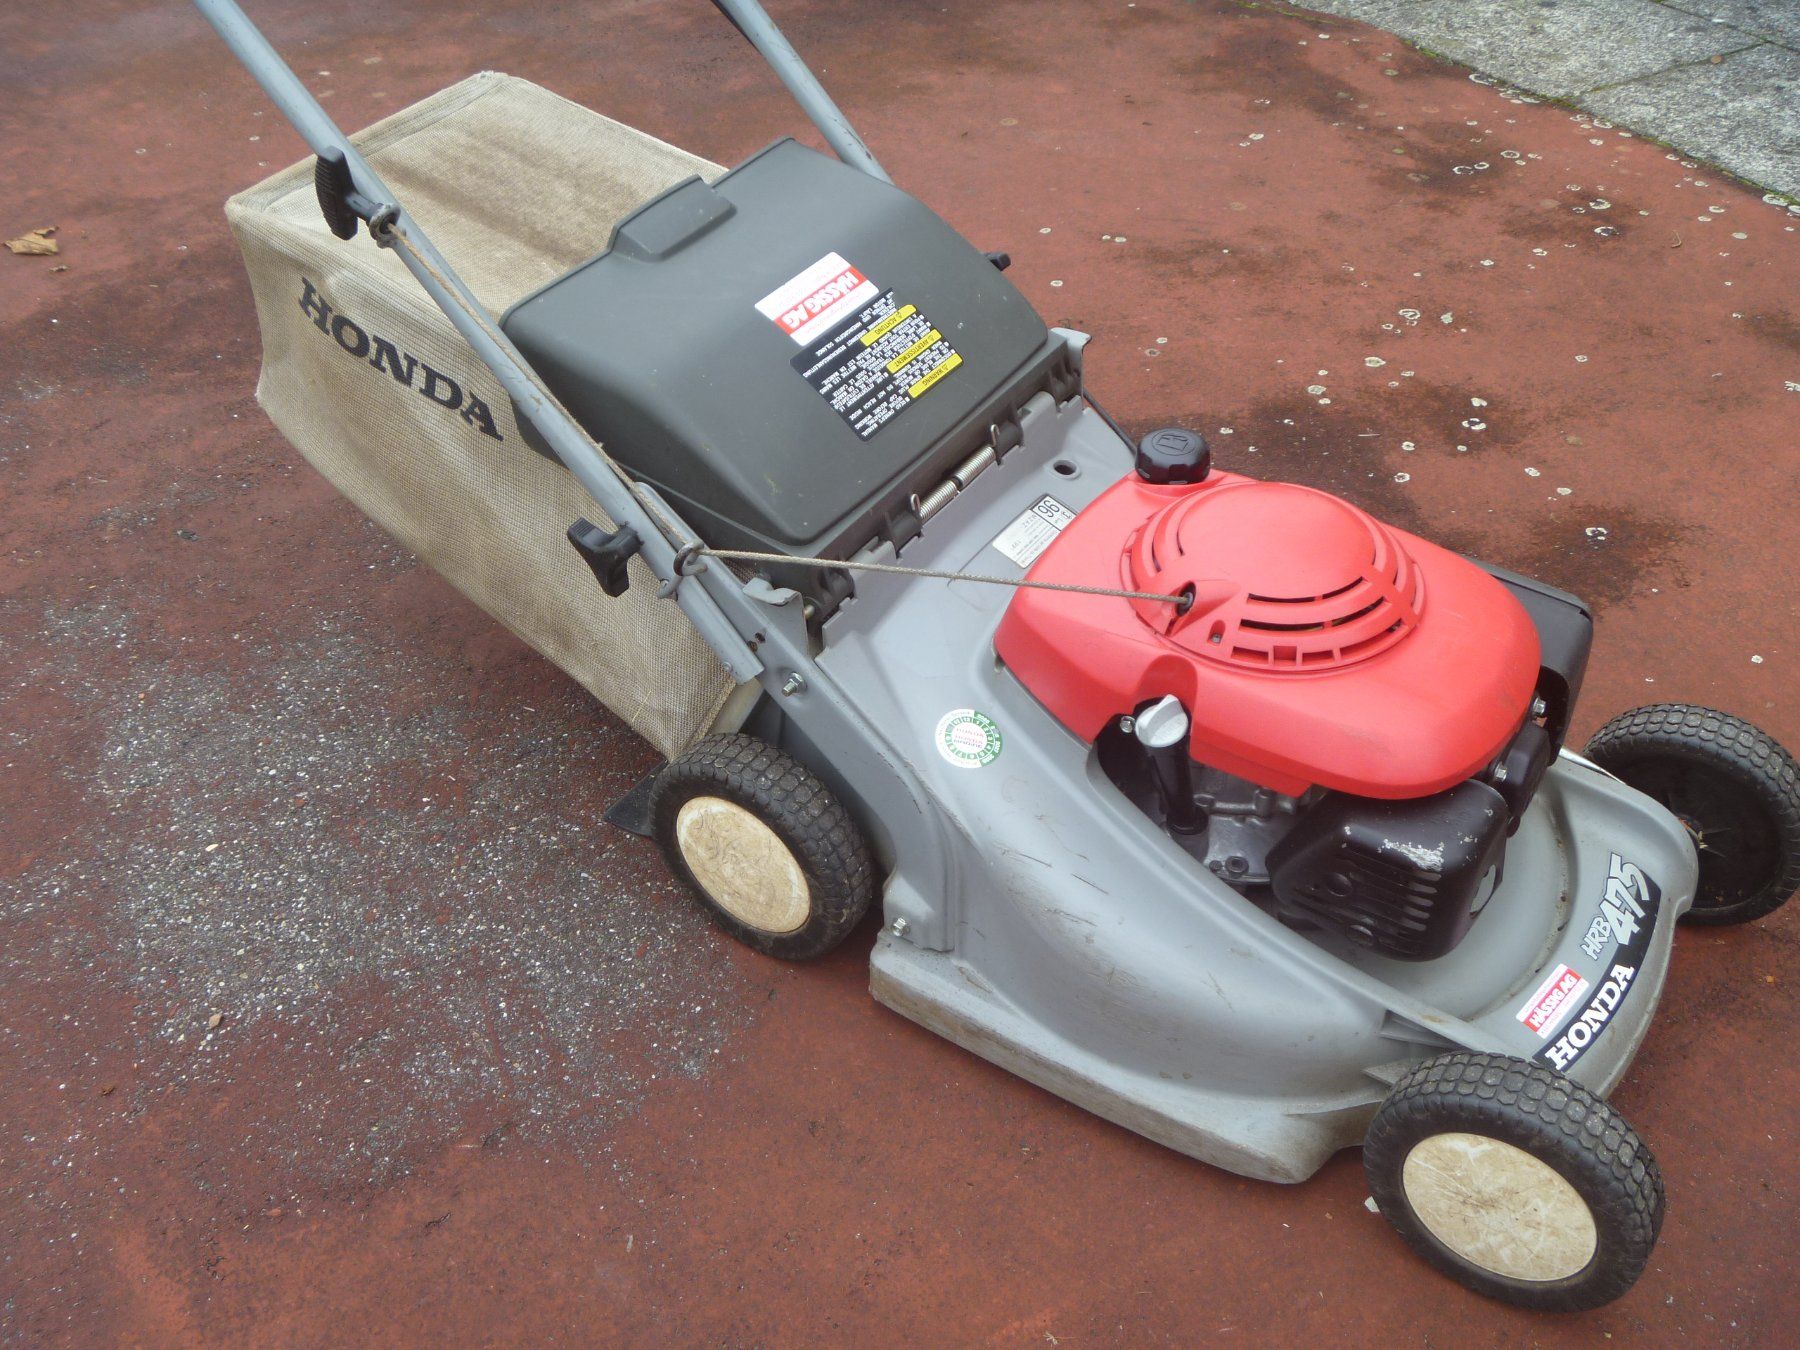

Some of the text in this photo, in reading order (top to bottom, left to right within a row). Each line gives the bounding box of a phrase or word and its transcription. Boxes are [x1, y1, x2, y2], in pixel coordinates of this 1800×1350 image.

[779, 303, 814, 330] AG
[873, 316, 897, 335] ACHTUNG
[300, 277, 504, 441] HONDA
[893, 337, 930, 367] AVERTISSEMENT
[920, 367, 944, 387] WARNING
[1038, 500, 1060, 517] 96
[1556, 972, 1578, 994] AG
[1545, 964, 1635, 1071] HONDA
